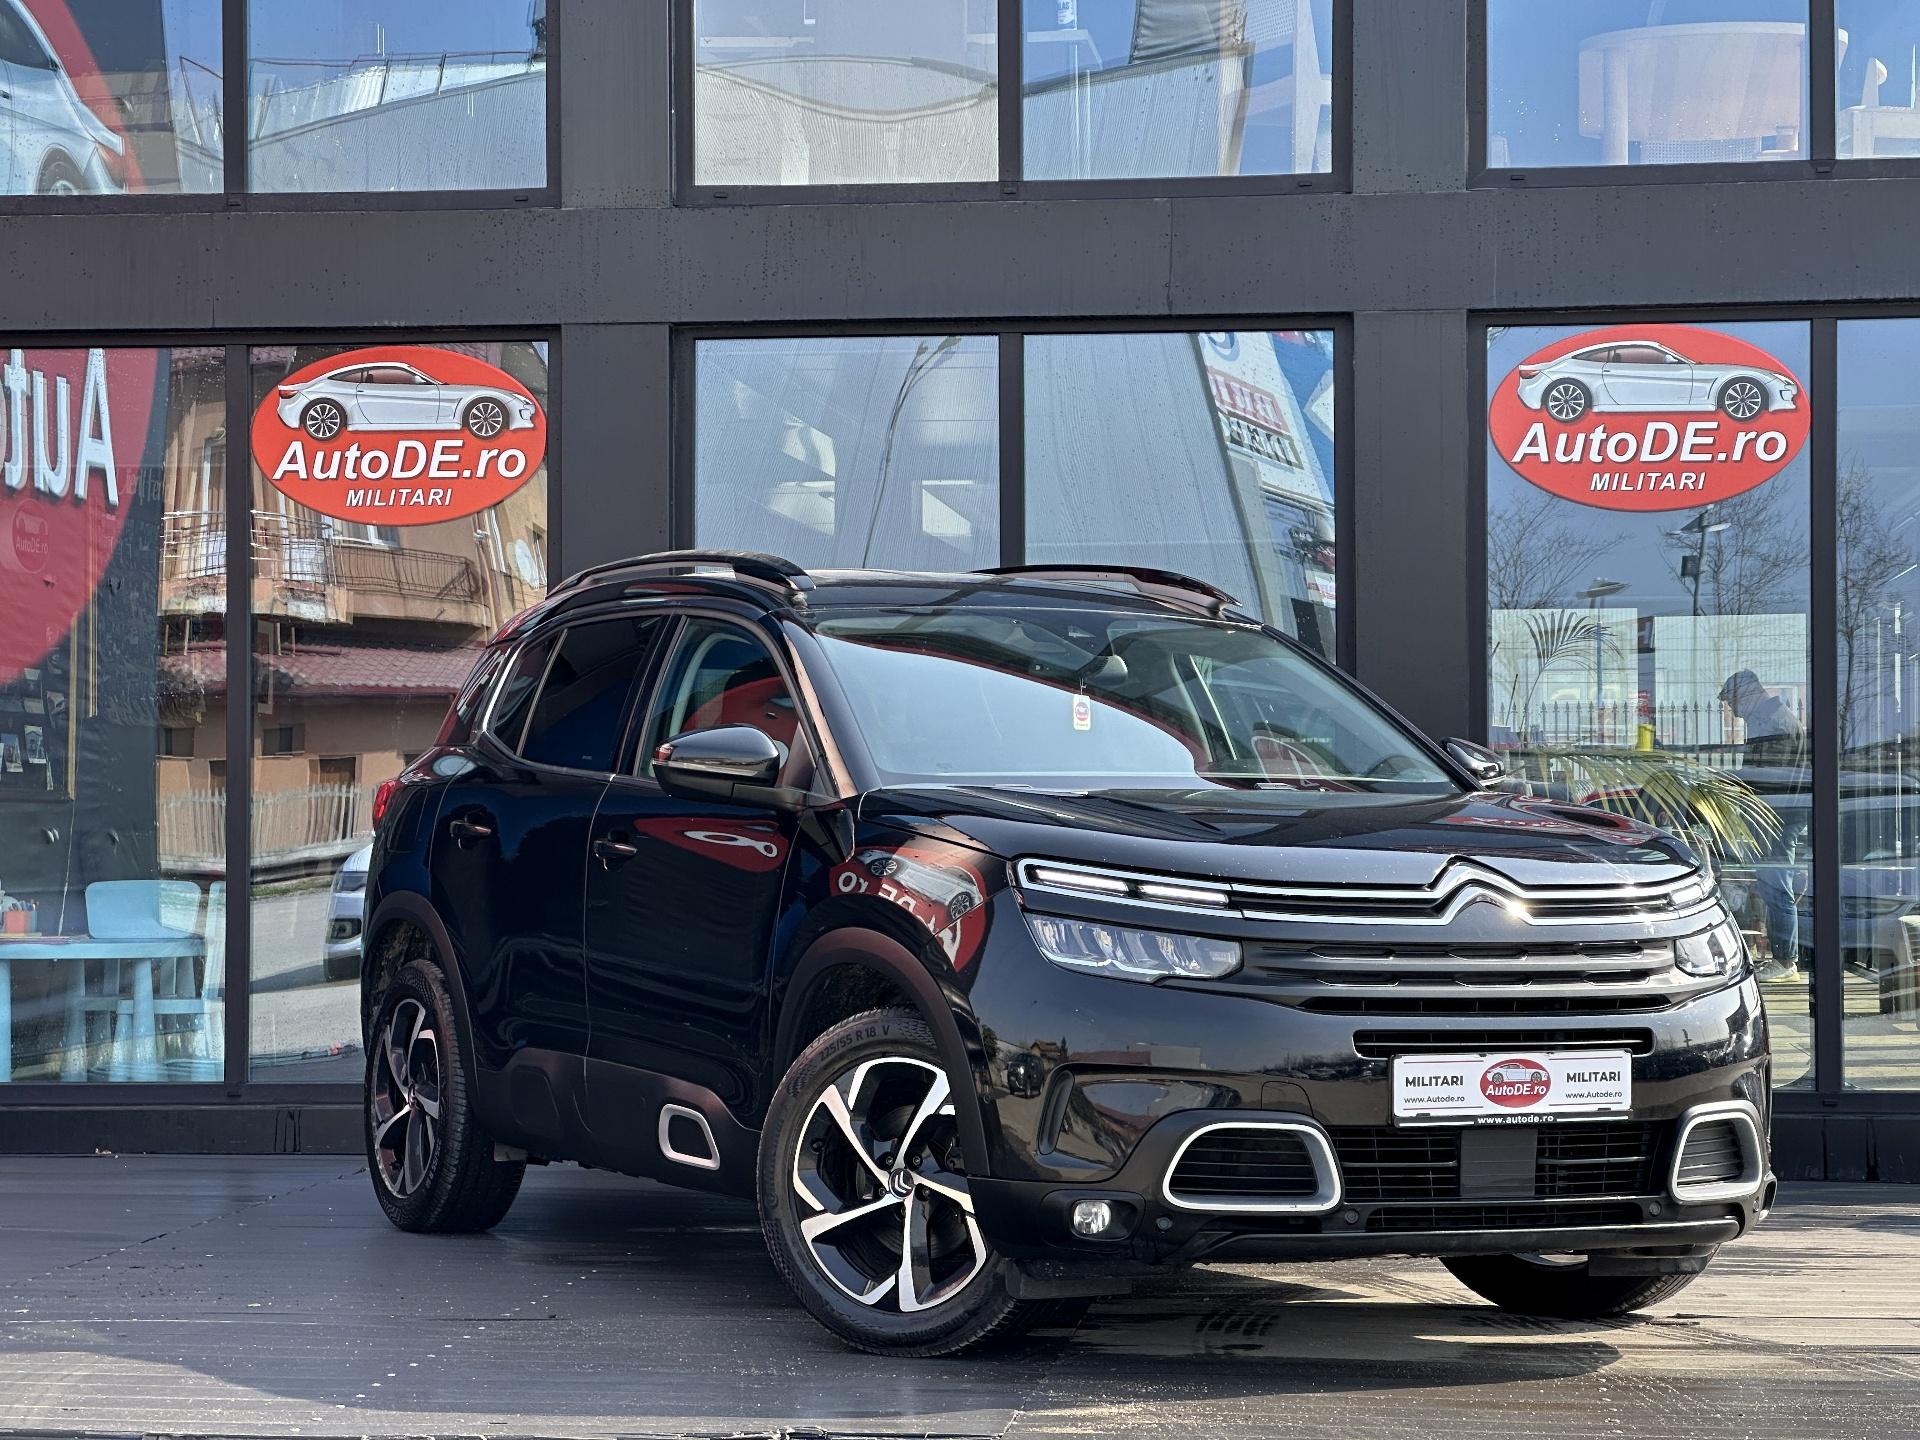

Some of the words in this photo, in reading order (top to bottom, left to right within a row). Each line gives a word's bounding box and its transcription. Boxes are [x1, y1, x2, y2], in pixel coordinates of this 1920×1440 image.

[1511, 421, 1787, 463] AutoDE.ro
[272, 439, 526, 480] AutoDE.ro
[1590, 472, 1706, 491] MILITARI
[346, 488, 452, 507] MILITARI
[856, 1031, 863, 1041] R
[865, 1026, 877, 1039] 18
[882, 1025, 891, 1035] V
[1405, 1075, 1464, 1087] MILITARI
[1566, 1071, 1621, 1083] MILITARI
[1485, 1083, 1547, 1097] AutoDE.ro
[1565, 1090, 1623, 1100] www.Autode.ro
[1403, 1094, 1465, 1104] www.Autode.ro
[1477, 1114, 1554, 1125] www.autode.ro
